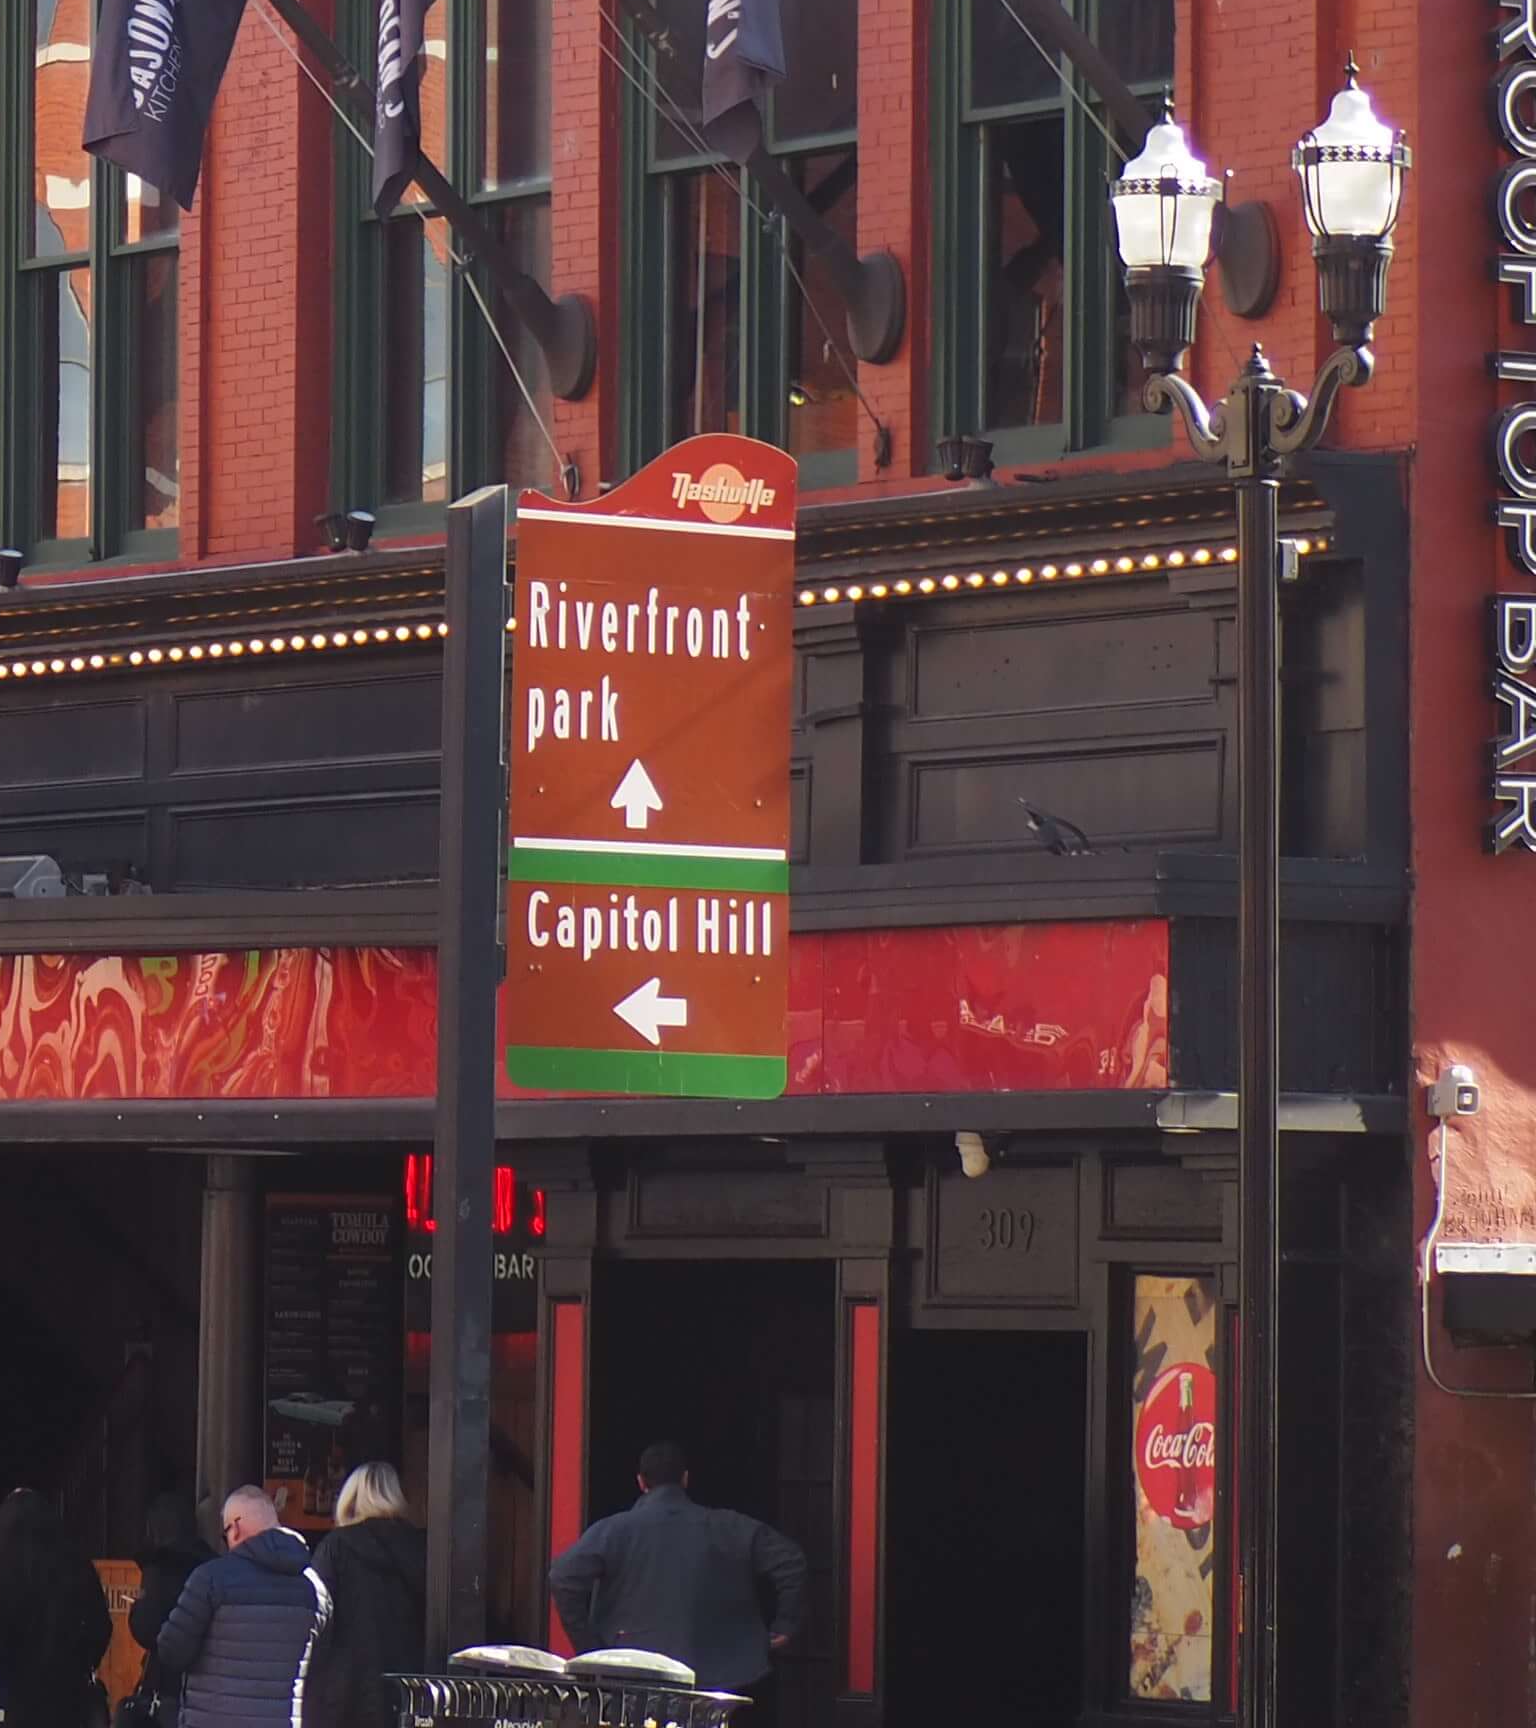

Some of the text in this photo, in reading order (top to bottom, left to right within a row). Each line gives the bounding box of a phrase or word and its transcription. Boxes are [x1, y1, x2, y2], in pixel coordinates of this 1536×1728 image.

[672, 472, 776, 514] Nashville
[529, 580, 751, 661] Riverfront
[528, 674, 620, 753] park
[1493, 593, 1536, 857] BAR
[527, 890, 772, 962] Capitol Hill
[331, 1228, 386, 1245] COWBOY
[979, 1208, 1034, 1253] 309
[494, 1253, 535, 1280] BAR
